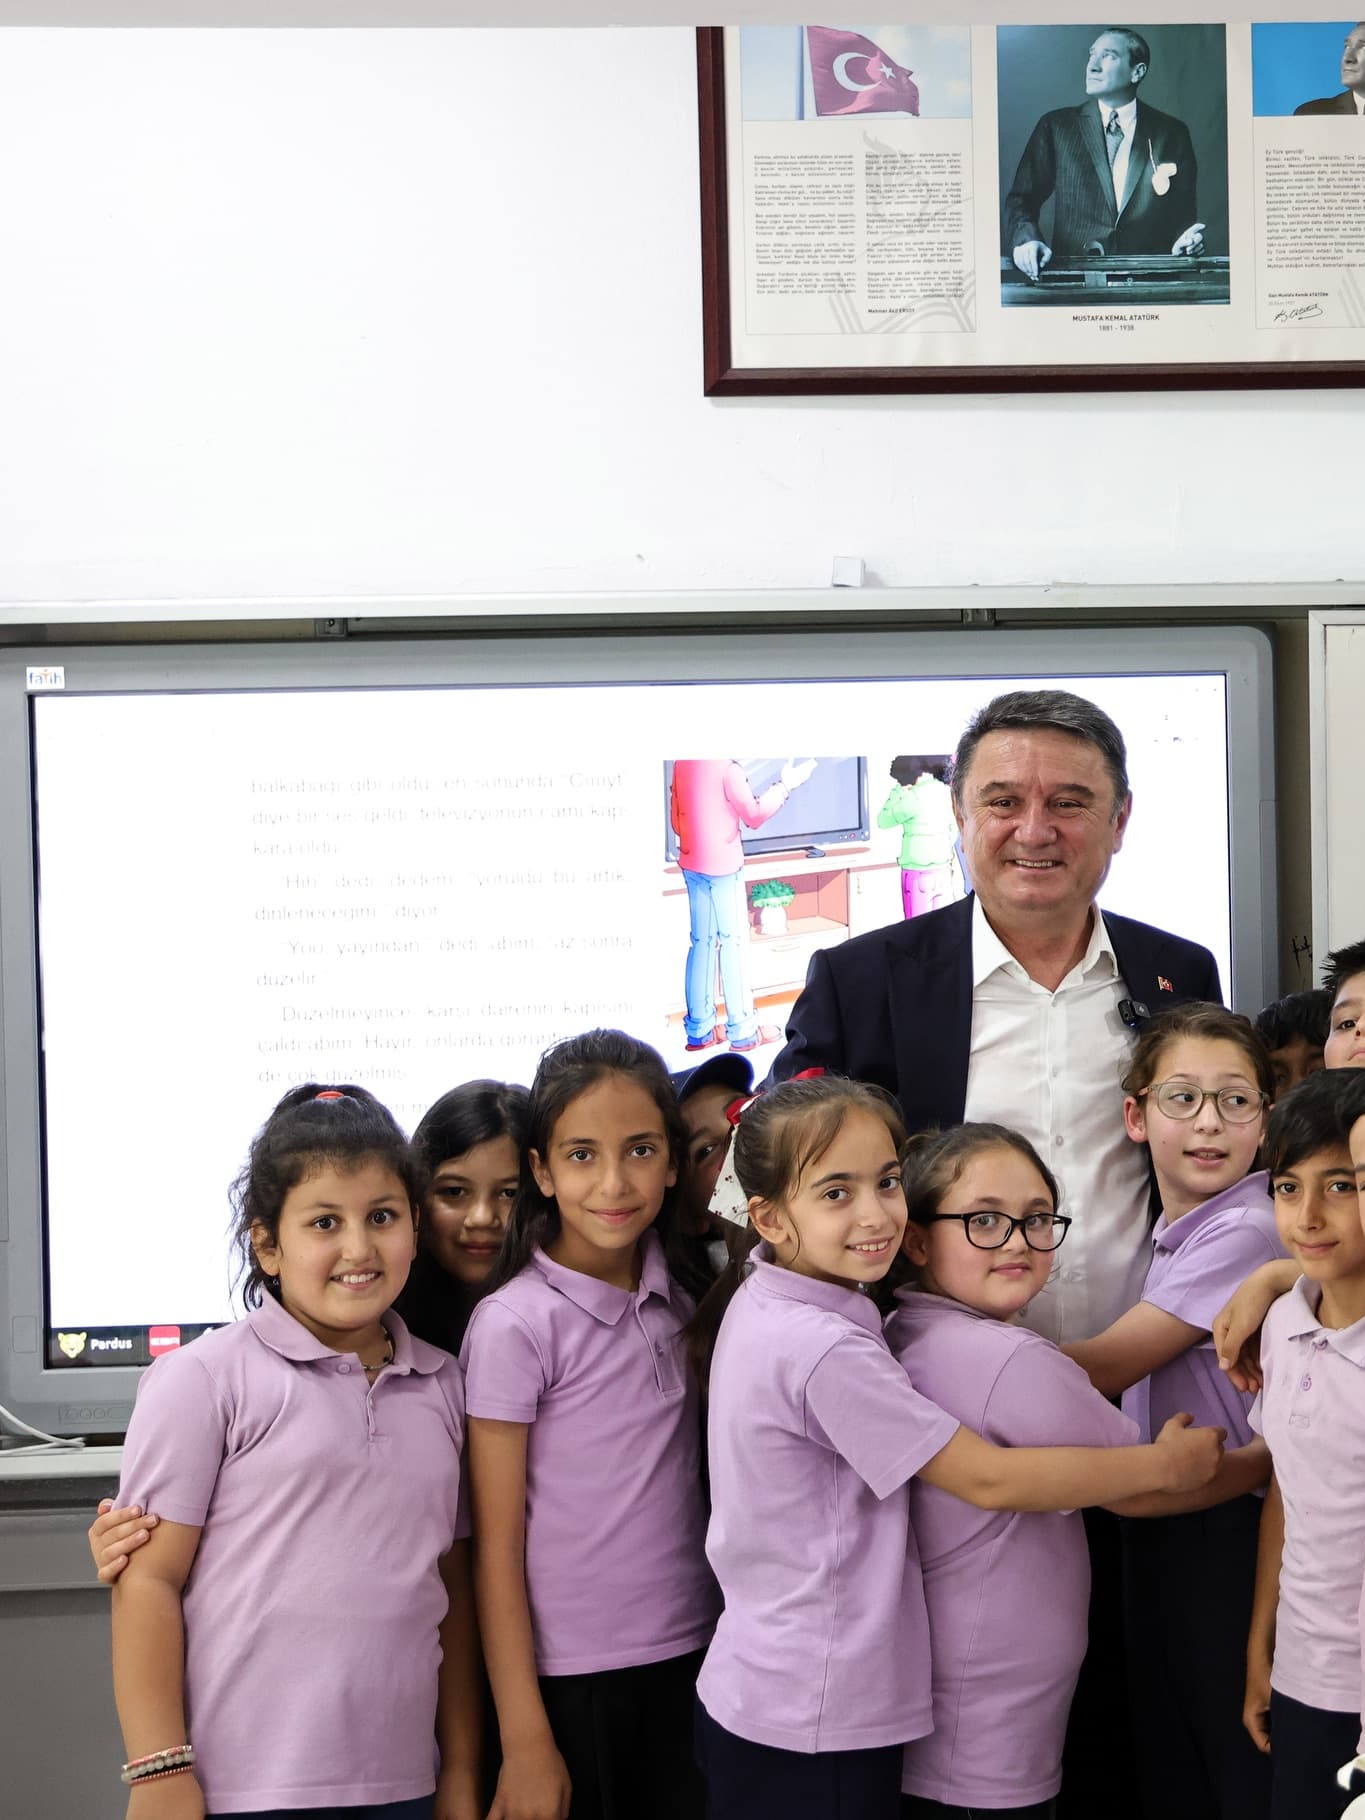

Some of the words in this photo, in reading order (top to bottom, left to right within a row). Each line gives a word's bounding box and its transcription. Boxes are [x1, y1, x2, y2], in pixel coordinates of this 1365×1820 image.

[1072, 314, 1104, 322] MUSTAFA
[1128, 312, 1160, 321] ATATÜRK
[90, 1337, 133, 1350] Pardus
